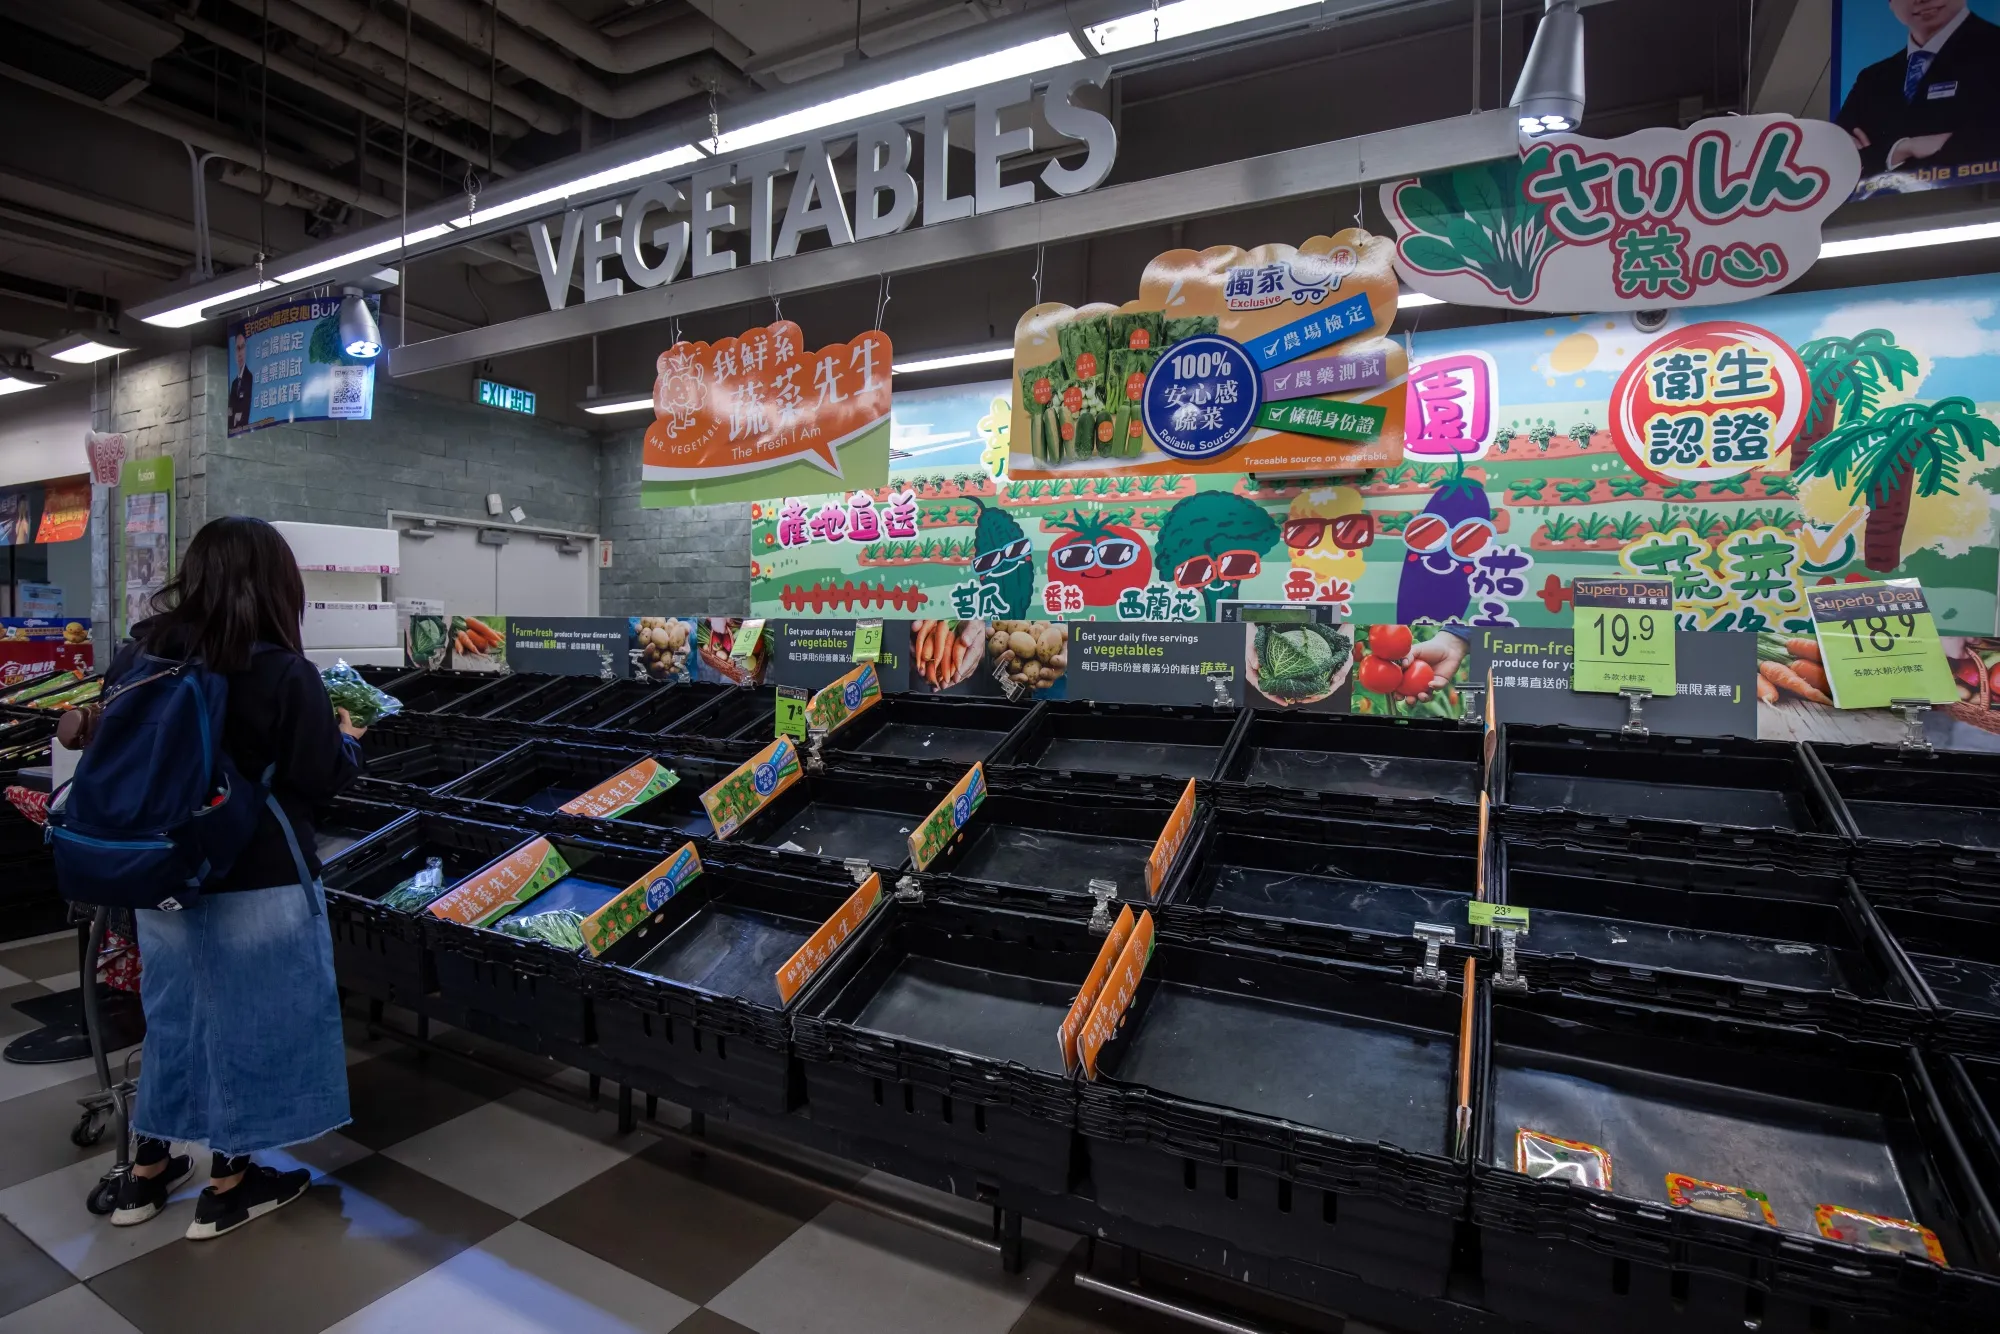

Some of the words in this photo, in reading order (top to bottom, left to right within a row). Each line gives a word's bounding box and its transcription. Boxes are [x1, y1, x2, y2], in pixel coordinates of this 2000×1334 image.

[1534, 132, 1816, 233] さいしん
[1958, 161, 2000, 178] sou
[528, 62, 1117, 310] VEGETABLES
[1621, 227, 1780, 293] 菜心
[1226, 265, 1284, 297] 獨家
[1230, 295, 1281, 308] Exclusive
[1284, 305, 1366, 351] 農場檢定
[1171, 351, 1231, 380] 100%
[1295, 358, 1380, 389] 農藥測試
[1652, 348, 1770, 400] 衛生
[480, 381, 509, 408] EXIT
[511, 389, 534, 413] 出口
[729, 338, 883, 441] 蔬菜先生
[1164, 380, 1239, 408] 安心感
[1403, 354, 1491, 455] 園
[1175, 406, 1224, 432] 蔬菜
[1288, 406, 1376, 435] 條碼身份證
[650, 436, 665, 452] MR.
[671, 416, 722, 454] VEGETABLE
[732, 447, 752, 460] The
[756, 435, 787, 453] Fresh
[800, 426, 821, 441] Am
[1159, 429, 1196, 450] Reliable
[1199, 427, 1236, 450] Source
[1650, 412, 1769, 465] 認證
[1244, 456, 1287, 465] Traceable
[1290, 456, 1322, 464] source
[1340, 452, 1387, 462] vegetable
[138, 470, 155, 481] fusion
[779, 493, 916, 546] 產地直送
[1631, 534, 1796, 602] 蔬菜
[952, 585, 1007, 619] 苦瓜
[1044, 584, 1082, 612] 番茄
[1119, 585, 1197, 620] 西蘭花
[1576, 582, 1628, 598] Superb
[1633, 584, 1668, 597] Deal
[1627, 597, 1669, 605] 精選優惠
[1814, 592, 1874, 611] Superb
[1878, 588, 1921, 604] Deal
[1877, 601, 1924, 613] 精選優惠
[592, 631, 608, 639] dinner
[788, 628, 800, 636] Get
[800, 629, 814, 637] your
[815, 628, 831, 637] daily
[831, 628, 843, 636] five
[797, 638, 848, 649] vegetables
[1081, 633, 1096, 641] Get
[1098, 634, 1117, 642] your
[1119, 633, 1140, 643] daily
[1141, 633, 1158, 642] five
[1160, 634, 1199, 645] servings
[1594, 613, 1655, 656] 19.9
[1842, 614, 1915, 653] 18.9
[1083, 647, 1092, 655] of
[1093, 644, 1164, 657] vegetables
[1492, 639, 1574, 655] Farm-fre
[1492, 659, 1539, 669] produce
[1542, 659, 1560, 669] for
[1562, 662, 1574, 671] yo
[779, 685, 794, 696] Superb
[1493, 676, 1574, 690] 由農場直送的
